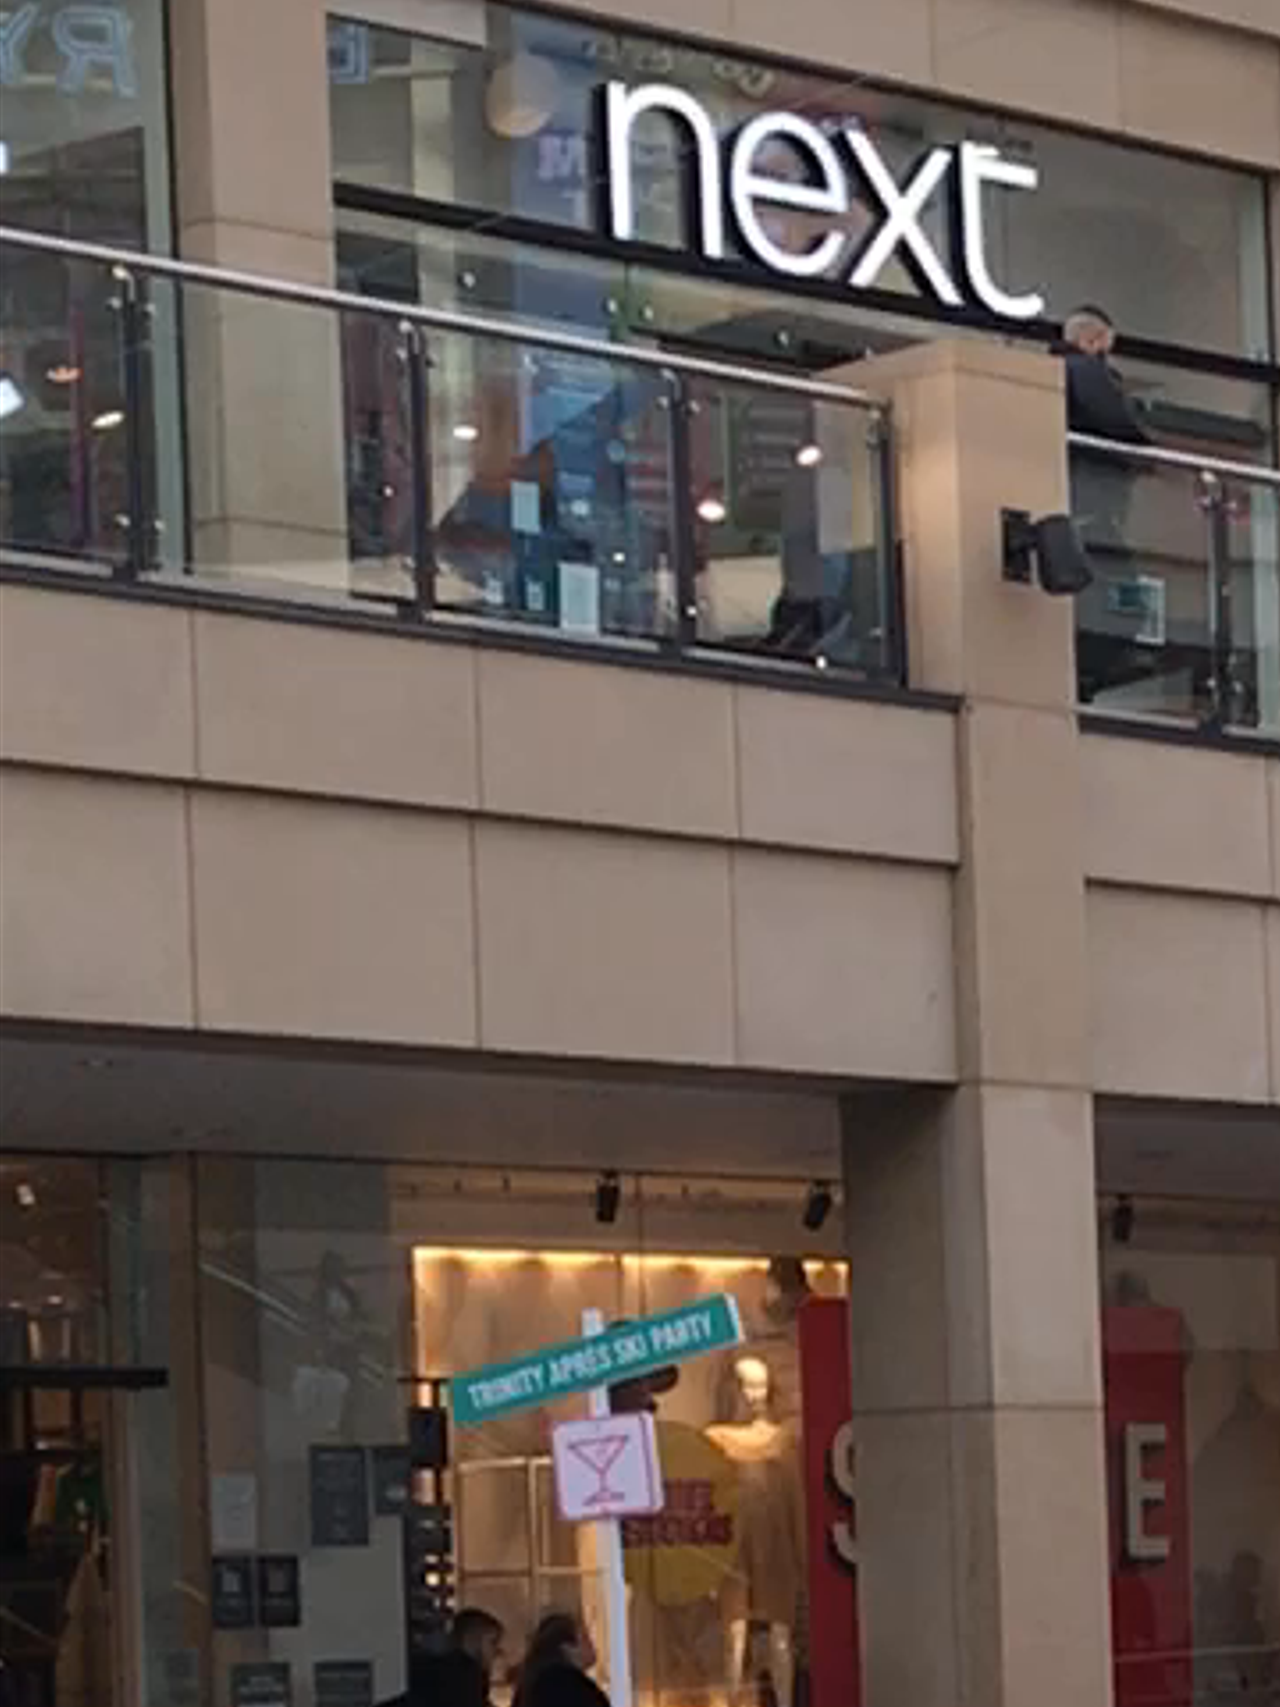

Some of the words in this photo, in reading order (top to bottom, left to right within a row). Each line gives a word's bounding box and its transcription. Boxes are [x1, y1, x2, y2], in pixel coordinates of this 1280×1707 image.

[606, 79, 1045, 318] next
[467, 1363, 544, 1409] TRINITY
[613, 1333, 647, 1366] SKI
[651, 1310, 712, 1353] PARTY
